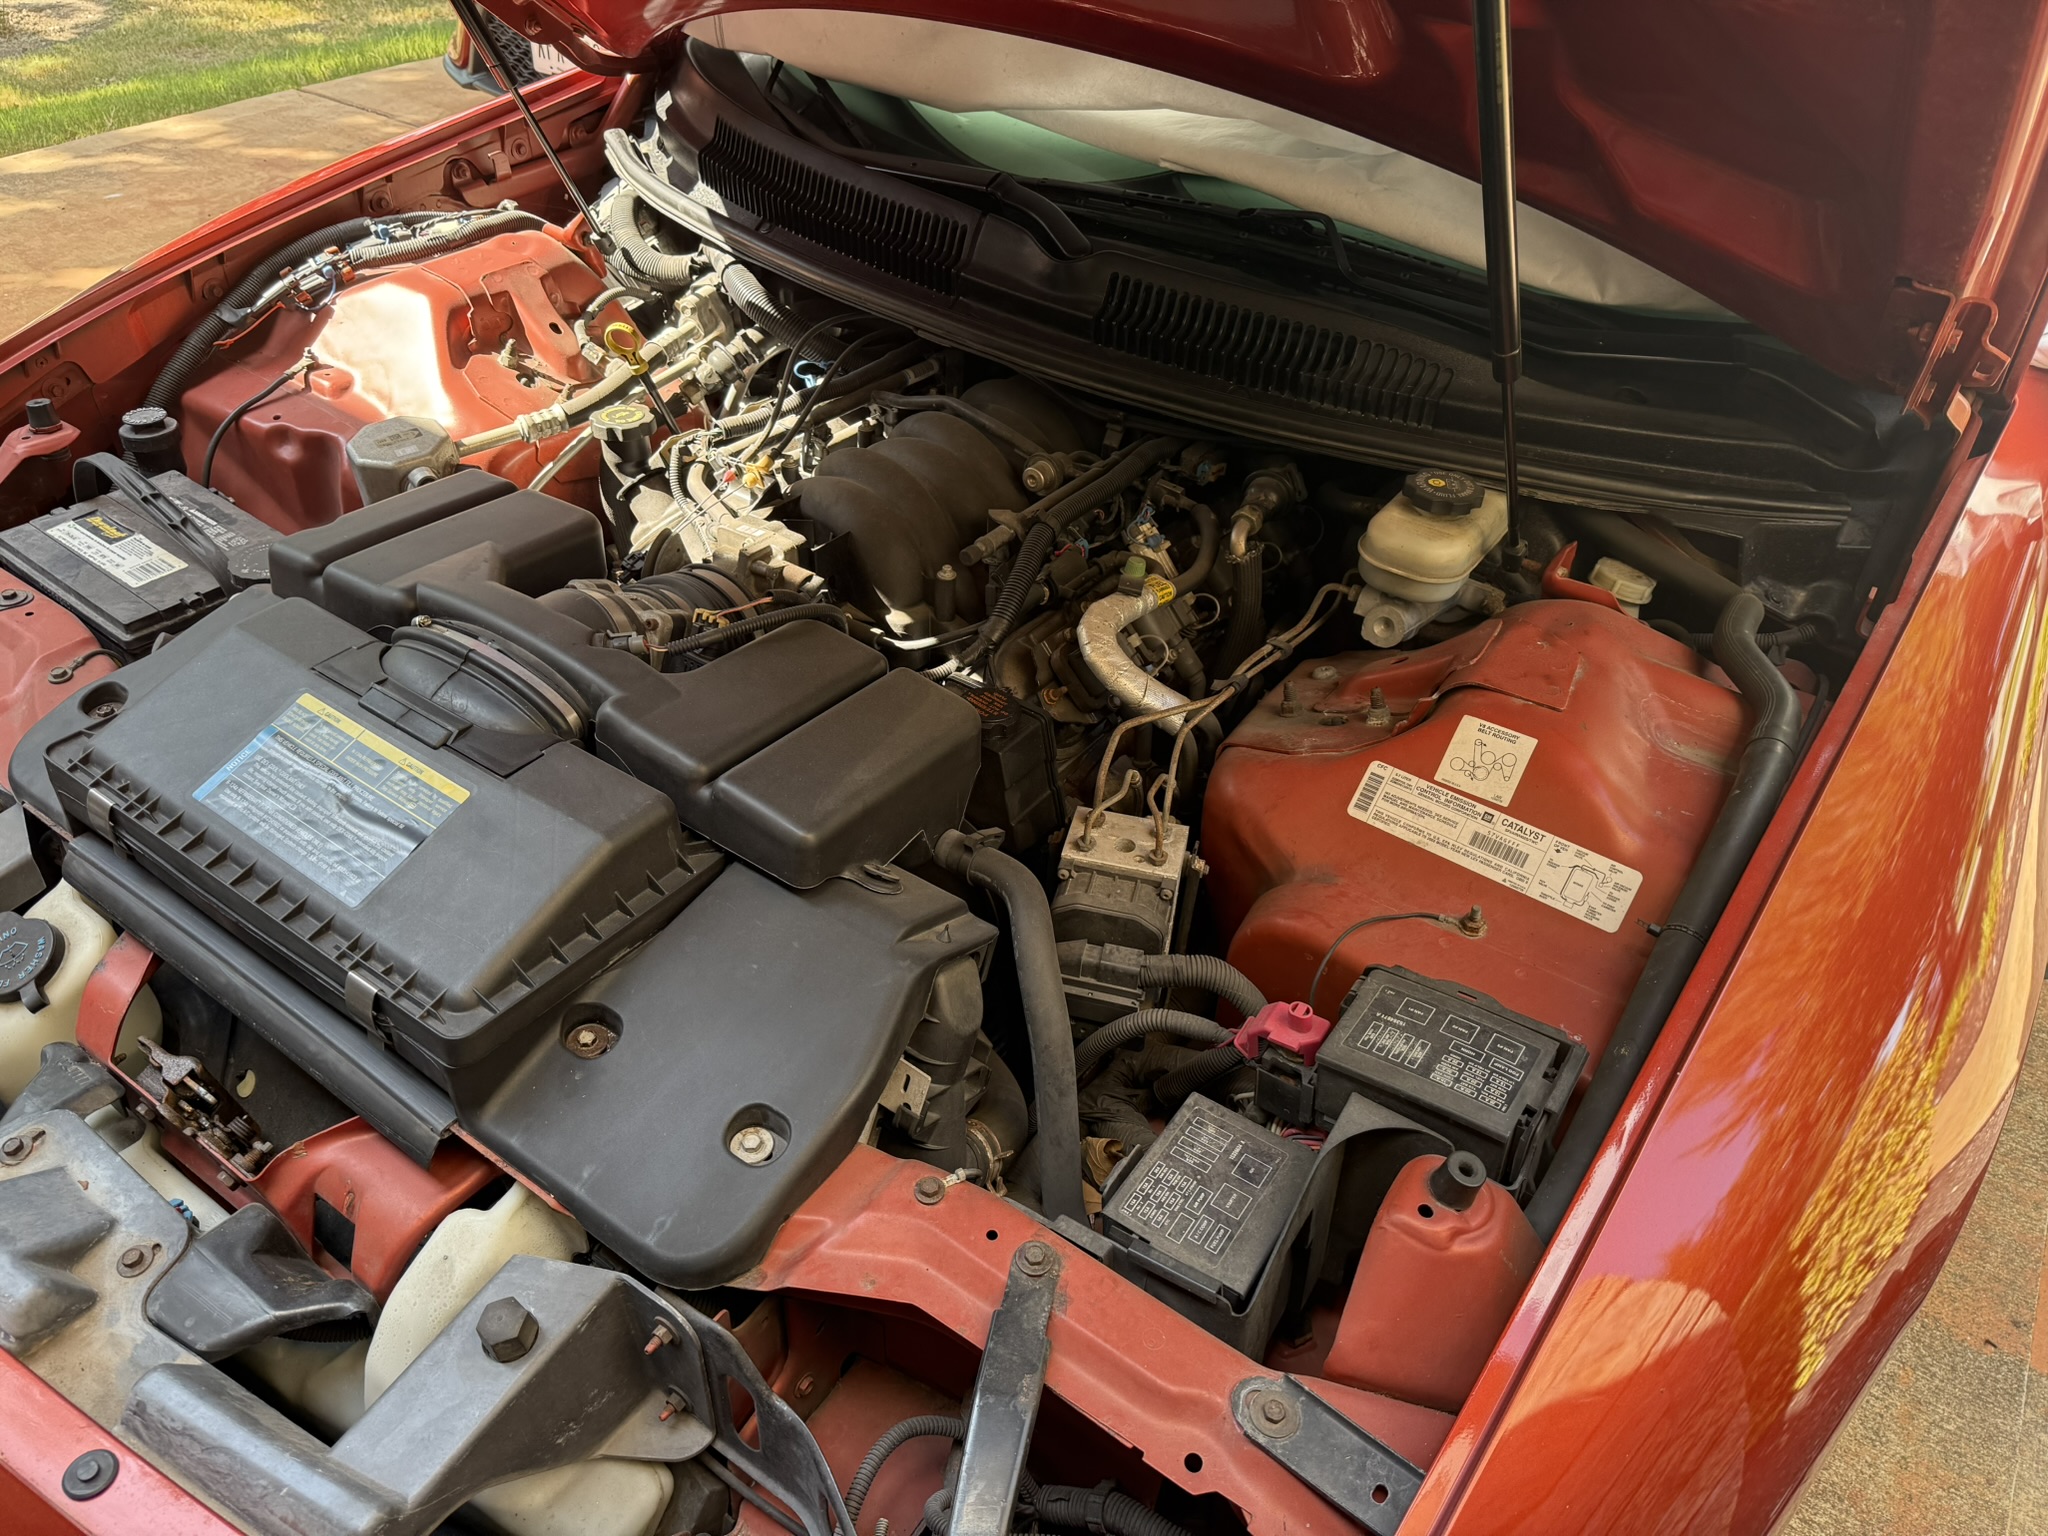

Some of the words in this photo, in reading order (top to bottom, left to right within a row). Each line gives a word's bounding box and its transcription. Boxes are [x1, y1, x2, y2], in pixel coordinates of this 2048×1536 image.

[1477, 728, 1491, 736] BELT
[1491, 733, 1517, 745] ROUTING
[1486, 726, 1520, 740] ACCESSORY
[225, 749, 251, 771] NOTICE
[1377, 763, 1388, 771] CFC
[1416, 786, 1443, 800] CONTROL
[1444, 798, 1482, 817] INFORMATION
[1417, 792, 1435, 801] GENERAL
[1435, 799, 1451, 809] MOTORS
[1451, 806, 1478, 820] CORPORATION
[1426, 784, 1450, 797] VEHICLE
[1450, 794, 1477, 809] EMISSION
[1409, 806, 1435, 819] MAINTENANCE
[1436, 818, 1457, 829] SCHEDULE
[1501, 818, 1546, 843] CATALYST
[1385, 814, 1402, 823] VEHICLE
[1463, 849, 1493, 865] REGULATIONS
[1504, 867, 1530, 881] CALIFORNIA
[1399, 824, 1421, 836] APPLICABLE
[1478, 860, 1502, 873] PASSENGER
[18, 935, 47, 980] WASHER
[1460, 1047, 1476, 1056] HORN
[1493, 1062, 1508, 1071] LAMP
[1197, 1192, 1206, 1202] PUMP
[1225, 1193, 1238, 1209] STARTER
[1199, 1219, 1209, 1231] COMP
[1210, 1238, 1219, 1249] FUEL
[1216, 1228, 1225, 1239] PUMP
